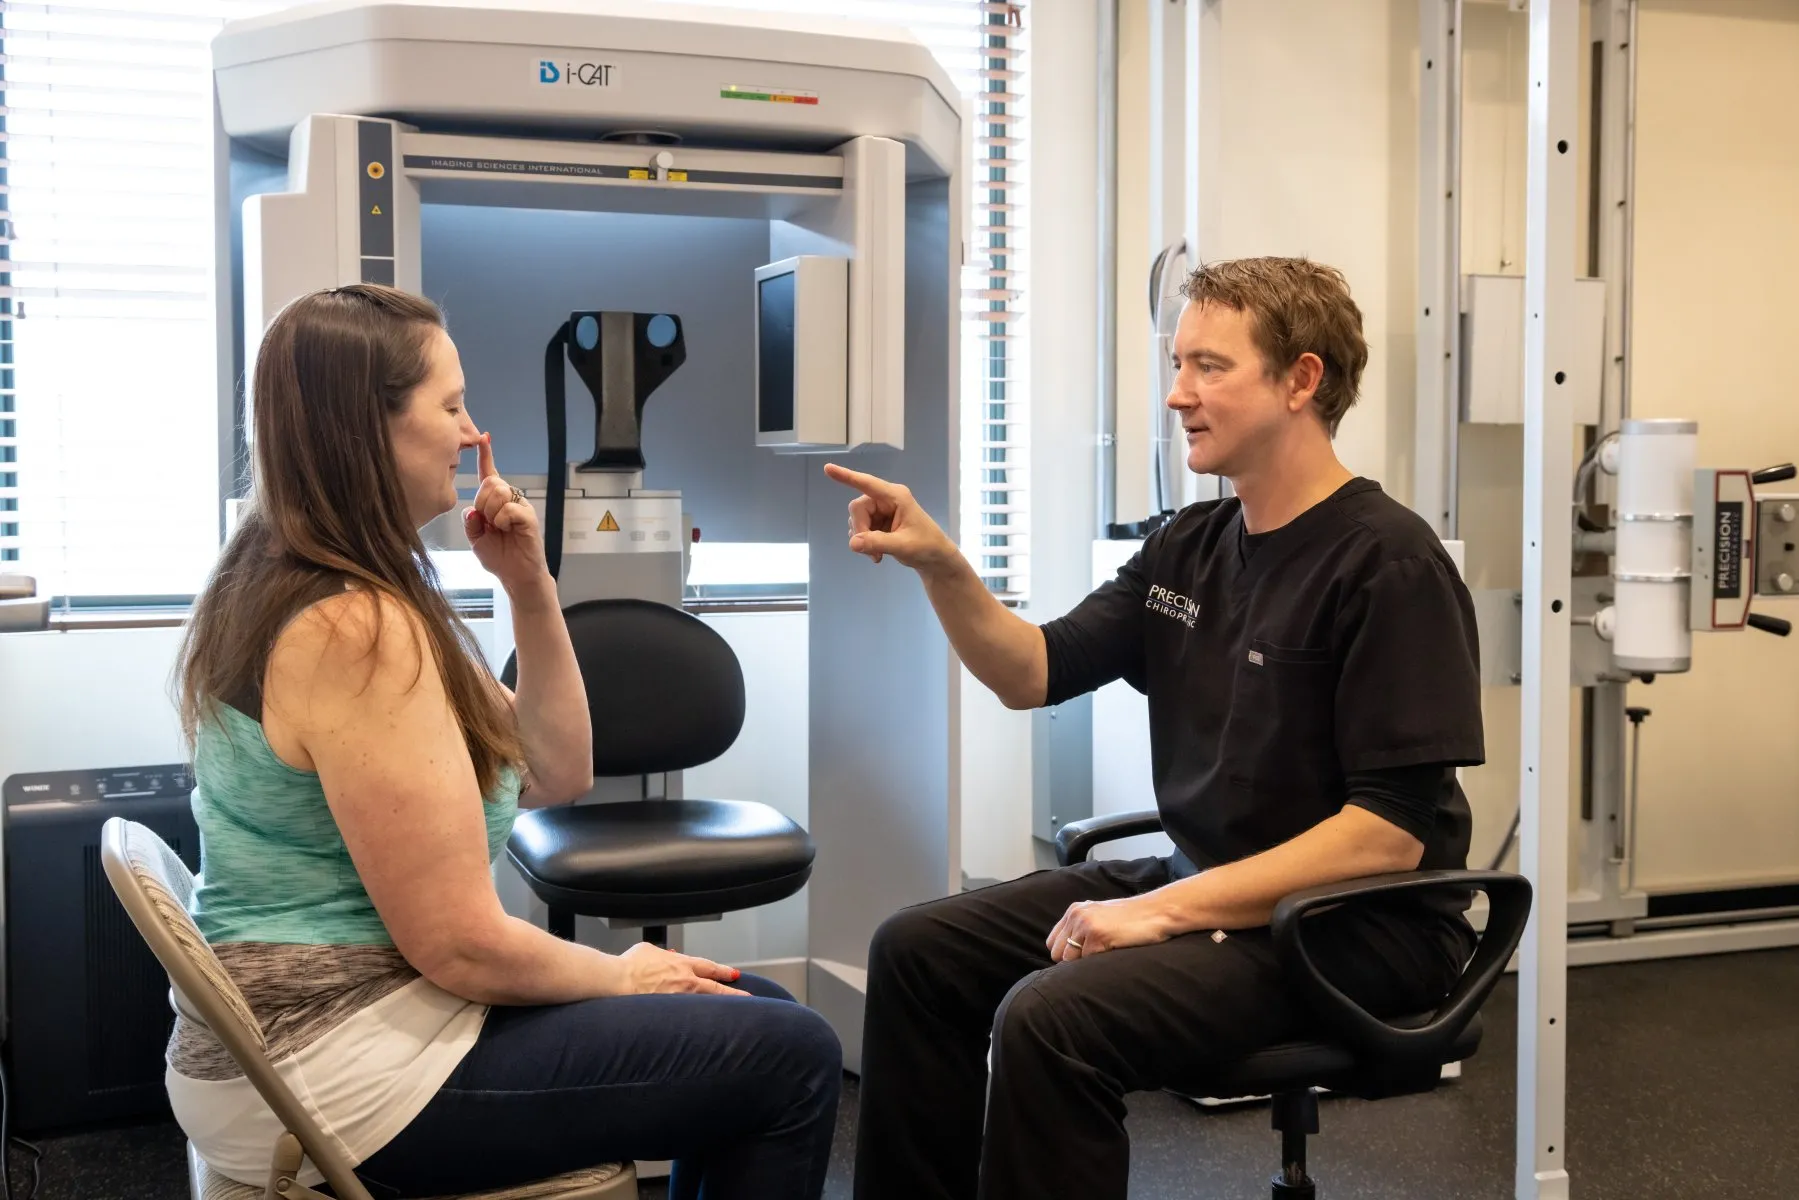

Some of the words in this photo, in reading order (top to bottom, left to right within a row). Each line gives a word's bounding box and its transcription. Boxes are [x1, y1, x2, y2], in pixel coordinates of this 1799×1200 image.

[566, 62, 613, 86] i-CAT
[430, 159, 473, 169] IMAGING
[476, 161, 525, 171] SCIENCES
[528, 164, 604, 175] INTERNATIONAL
[1717, 511, 1732, 589] PRECISION
